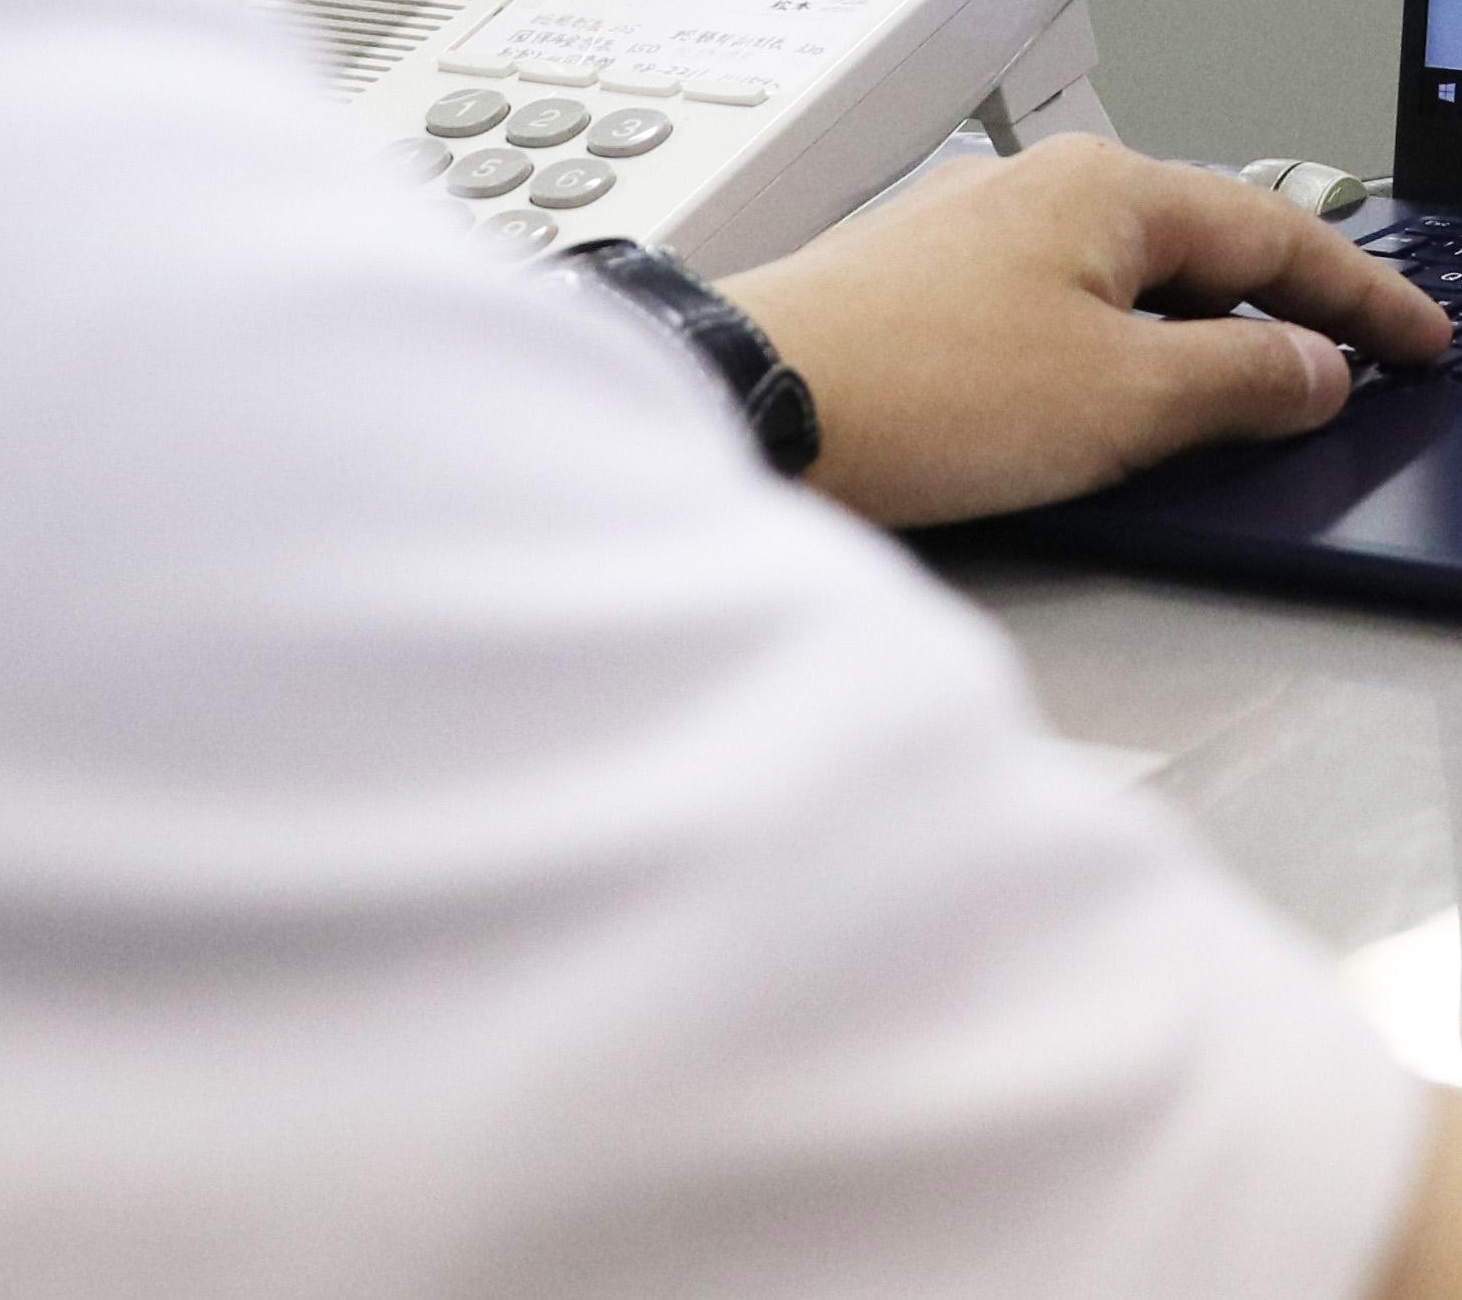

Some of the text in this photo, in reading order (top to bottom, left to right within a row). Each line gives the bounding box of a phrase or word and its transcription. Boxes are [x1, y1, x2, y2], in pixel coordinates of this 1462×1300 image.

[456, 102, 643, 138] 1 2 3
[472, 157, 585, 187] 5 6
[1440, 272, 1462, 283] Q
